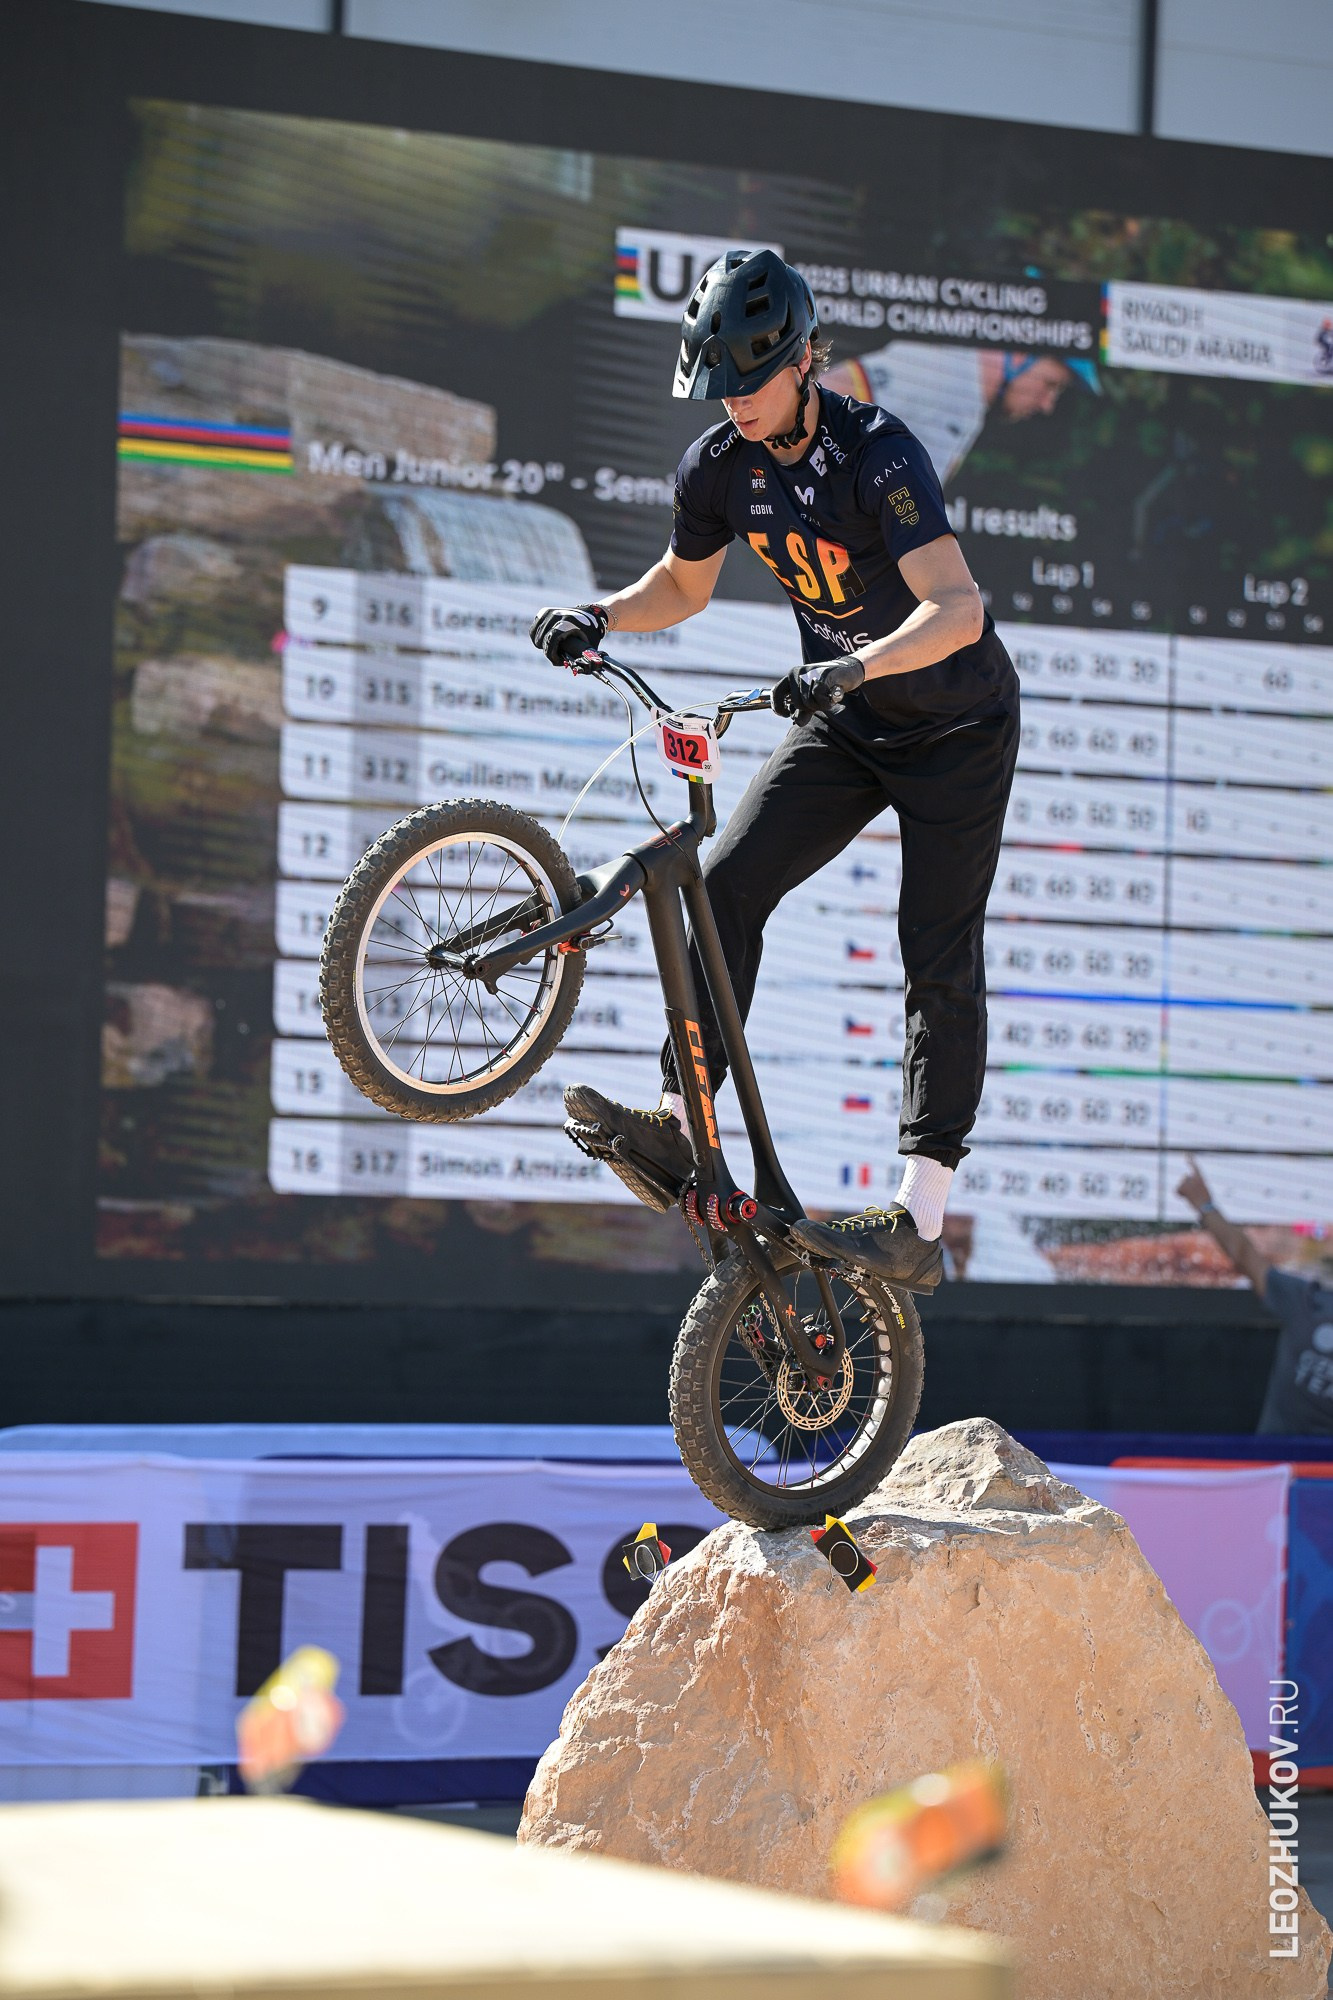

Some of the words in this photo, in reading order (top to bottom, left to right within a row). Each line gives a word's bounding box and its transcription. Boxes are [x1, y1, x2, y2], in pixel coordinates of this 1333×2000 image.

[647, 248, 717, 304] U
[851, 266, 938, 302] URBAN
[940, 277, 1048, 315] CYCLING
[886, 303, 1093, 350] CHAMPIONSHIPS
[1121, 299, 1204, 328] RIYADH
[1121, 328, 1188, 358] SAUDI
[1195, 335, 1274, 365] ARABIA
[306, 440, 387, 478] Men
[391, 450, 498, 489] Junior
[873, 456, 908, 488] RALI
[750, 504, 774, 515] GOBIK
[887, 485, 920, 526] ESP
[971, 504, 1078, 542] results
[747, 530, 851, 605] ESP
[1032, 555, 1080, 592] Lap
[1082, 559, 1095, 589] 1
[1243, 571, 1290, 608] Lap
[1291, 577, 1309, 606] 2
[306, 674, 336, 700] 10
[667, 732, 702, 764] 312
[303, 754, 331, 780] 11
[290, 1148, 322, 1174] 16
